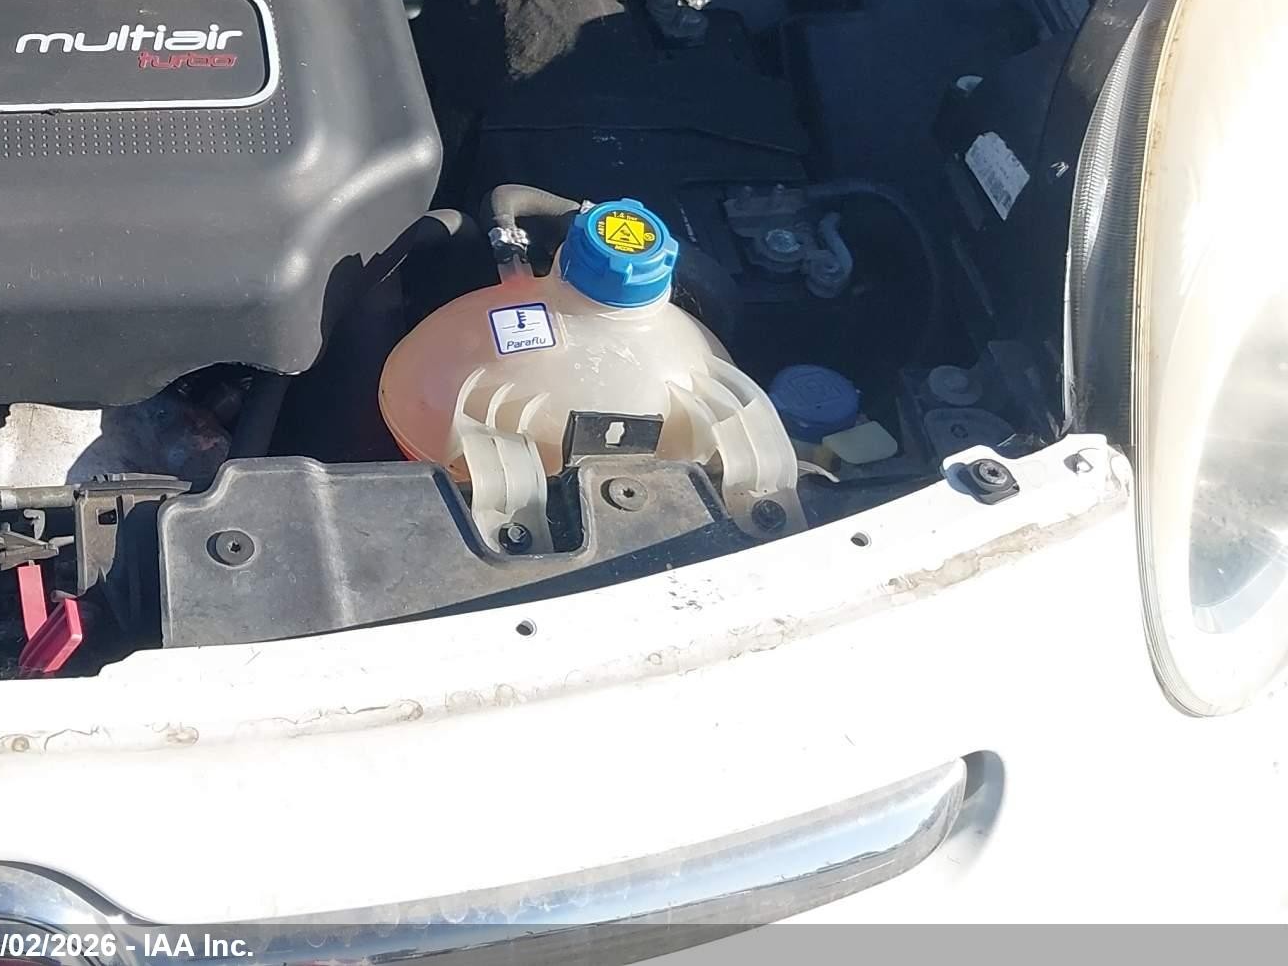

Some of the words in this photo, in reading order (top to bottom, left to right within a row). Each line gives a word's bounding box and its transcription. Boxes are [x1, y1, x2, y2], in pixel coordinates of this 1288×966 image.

[16, 23, 243, 54] multiair
[138, 50, 238, 69] turbo
[506, 336, 547, 351] Paraflu
